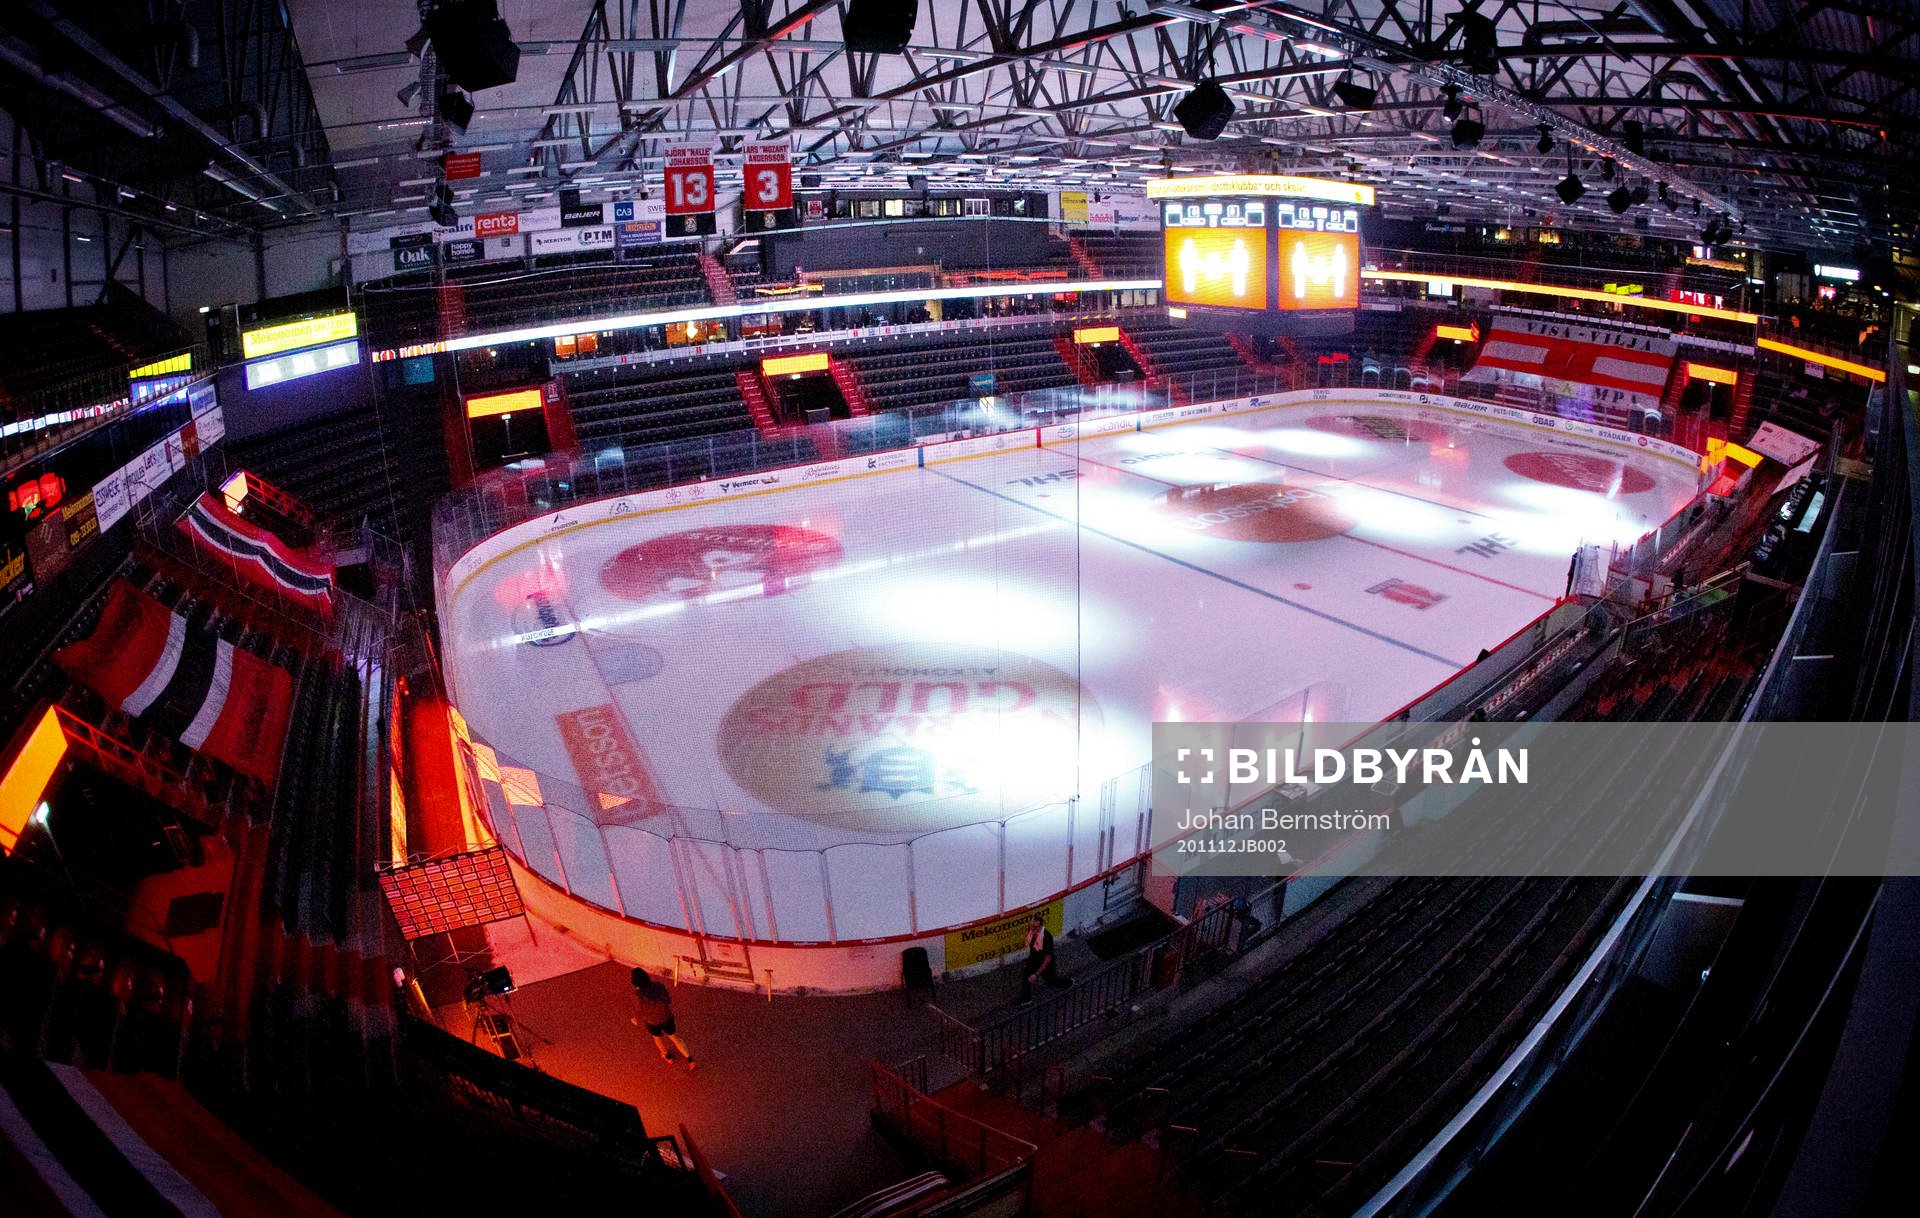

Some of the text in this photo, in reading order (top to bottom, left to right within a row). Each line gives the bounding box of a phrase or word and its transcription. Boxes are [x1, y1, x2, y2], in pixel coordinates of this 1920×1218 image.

[665, 147, 686, 156] BJÖRN
[743, 146, 758, 154] LARS
[669, 156, 708, 165] JOHANSSON
[748, 154, 785, 162] ANDERSSON
[671, 171, 708, 206] 13
[757, 170, 779, 202] 3
[477, 215, 516, 230] renta
[584, 230, 612, 241] PTM
[451, 241, 473, 251] happy
[451, 248, 475, 256] homes
[400, 247, 431, 264] Oak
[251, 324, 312, 346] Mekonomen
[1453, 400, 1488, 413] BAUER
[1097, 417, 1134, 433] Scandic
[732, 477, 760, 488] Vermeer
[961, 908, 1050, 942] Mekonomen
